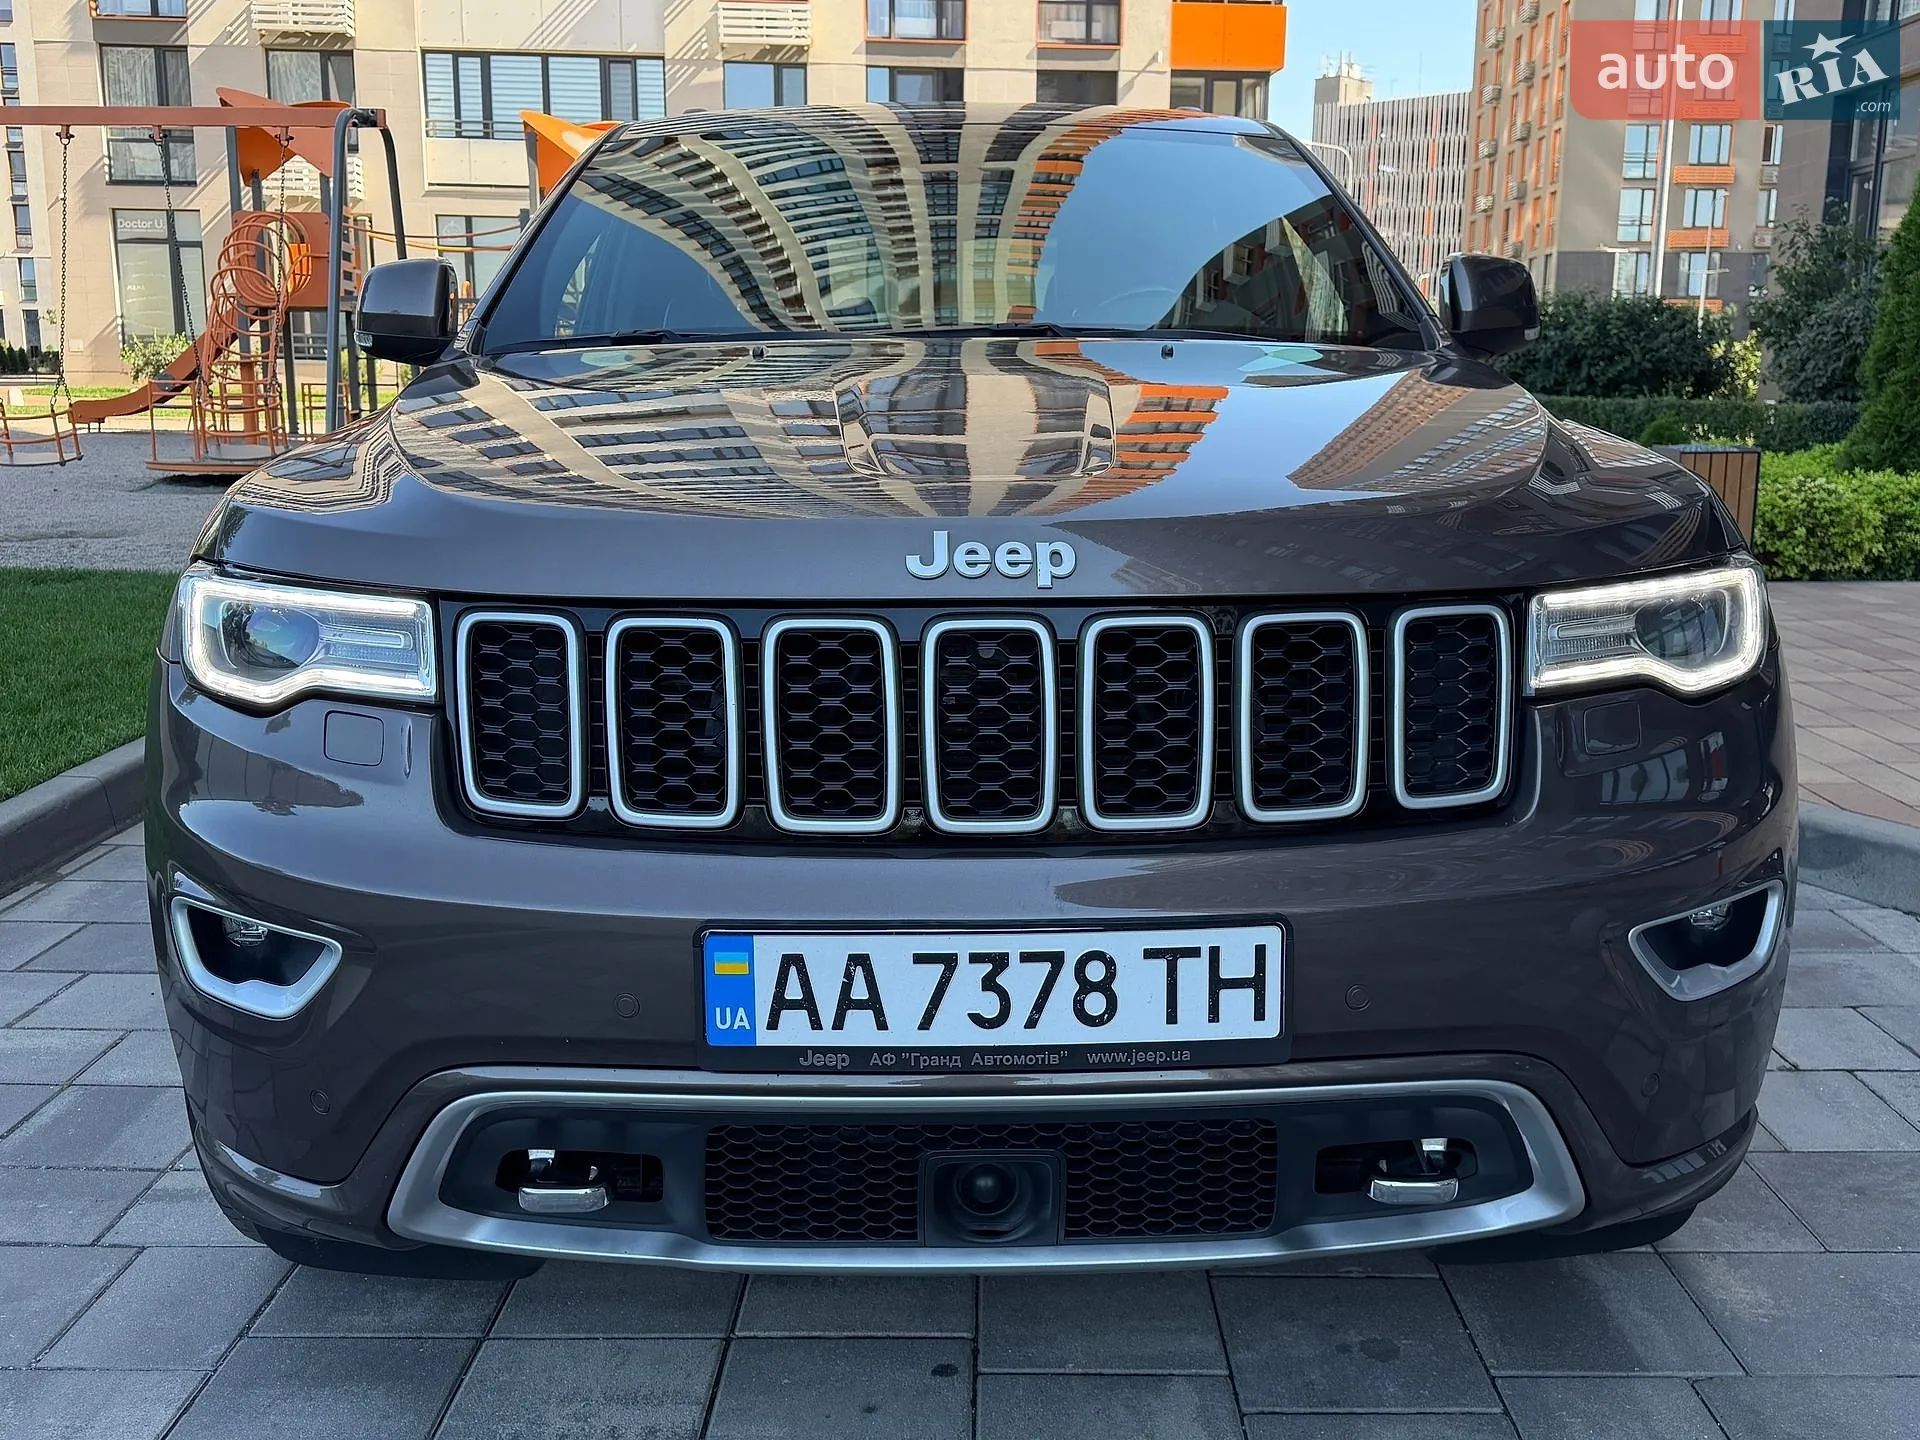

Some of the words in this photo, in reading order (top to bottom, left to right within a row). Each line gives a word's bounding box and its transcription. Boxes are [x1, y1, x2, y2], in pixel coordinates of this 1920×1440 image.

[117, 219, 153, 228] Doctor
[905, 530, 1077, 589] Jeep
[765, 952, 890, 1032] AA
[911, 949, 1118, 1031] 7378
[1142, 943, 1267, 1026] TH
[714, 1006, 752, 1031] UA
[799, 1049, 850, 1070] Jeep
[869, 1052, 897, 1067] АФ
[1086, 1049, 1192, 1066] www.jeep.ua
